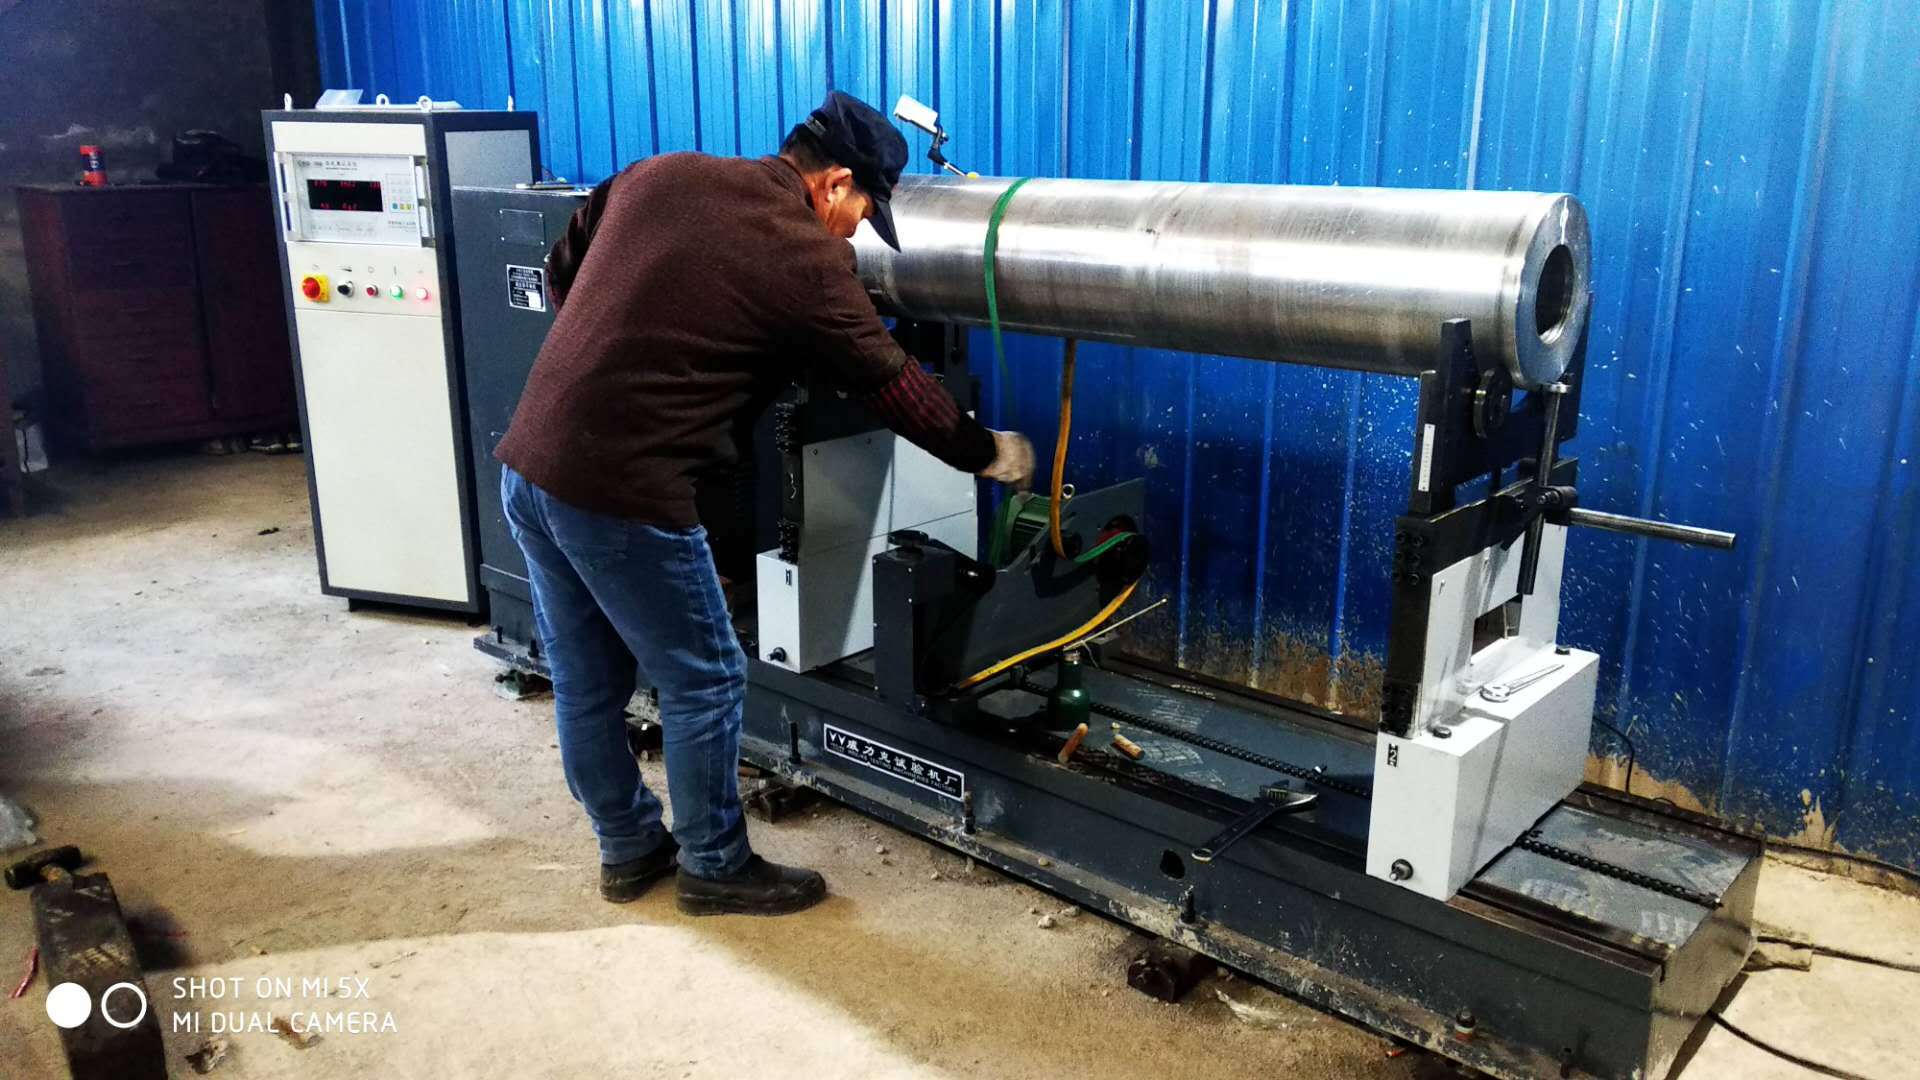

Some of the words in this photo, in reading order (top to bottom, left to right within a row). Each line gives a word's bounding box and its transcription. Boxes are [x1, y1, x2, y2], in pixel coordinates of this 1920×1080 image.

[846, 740, 958, 785] 威力克试验机厂
